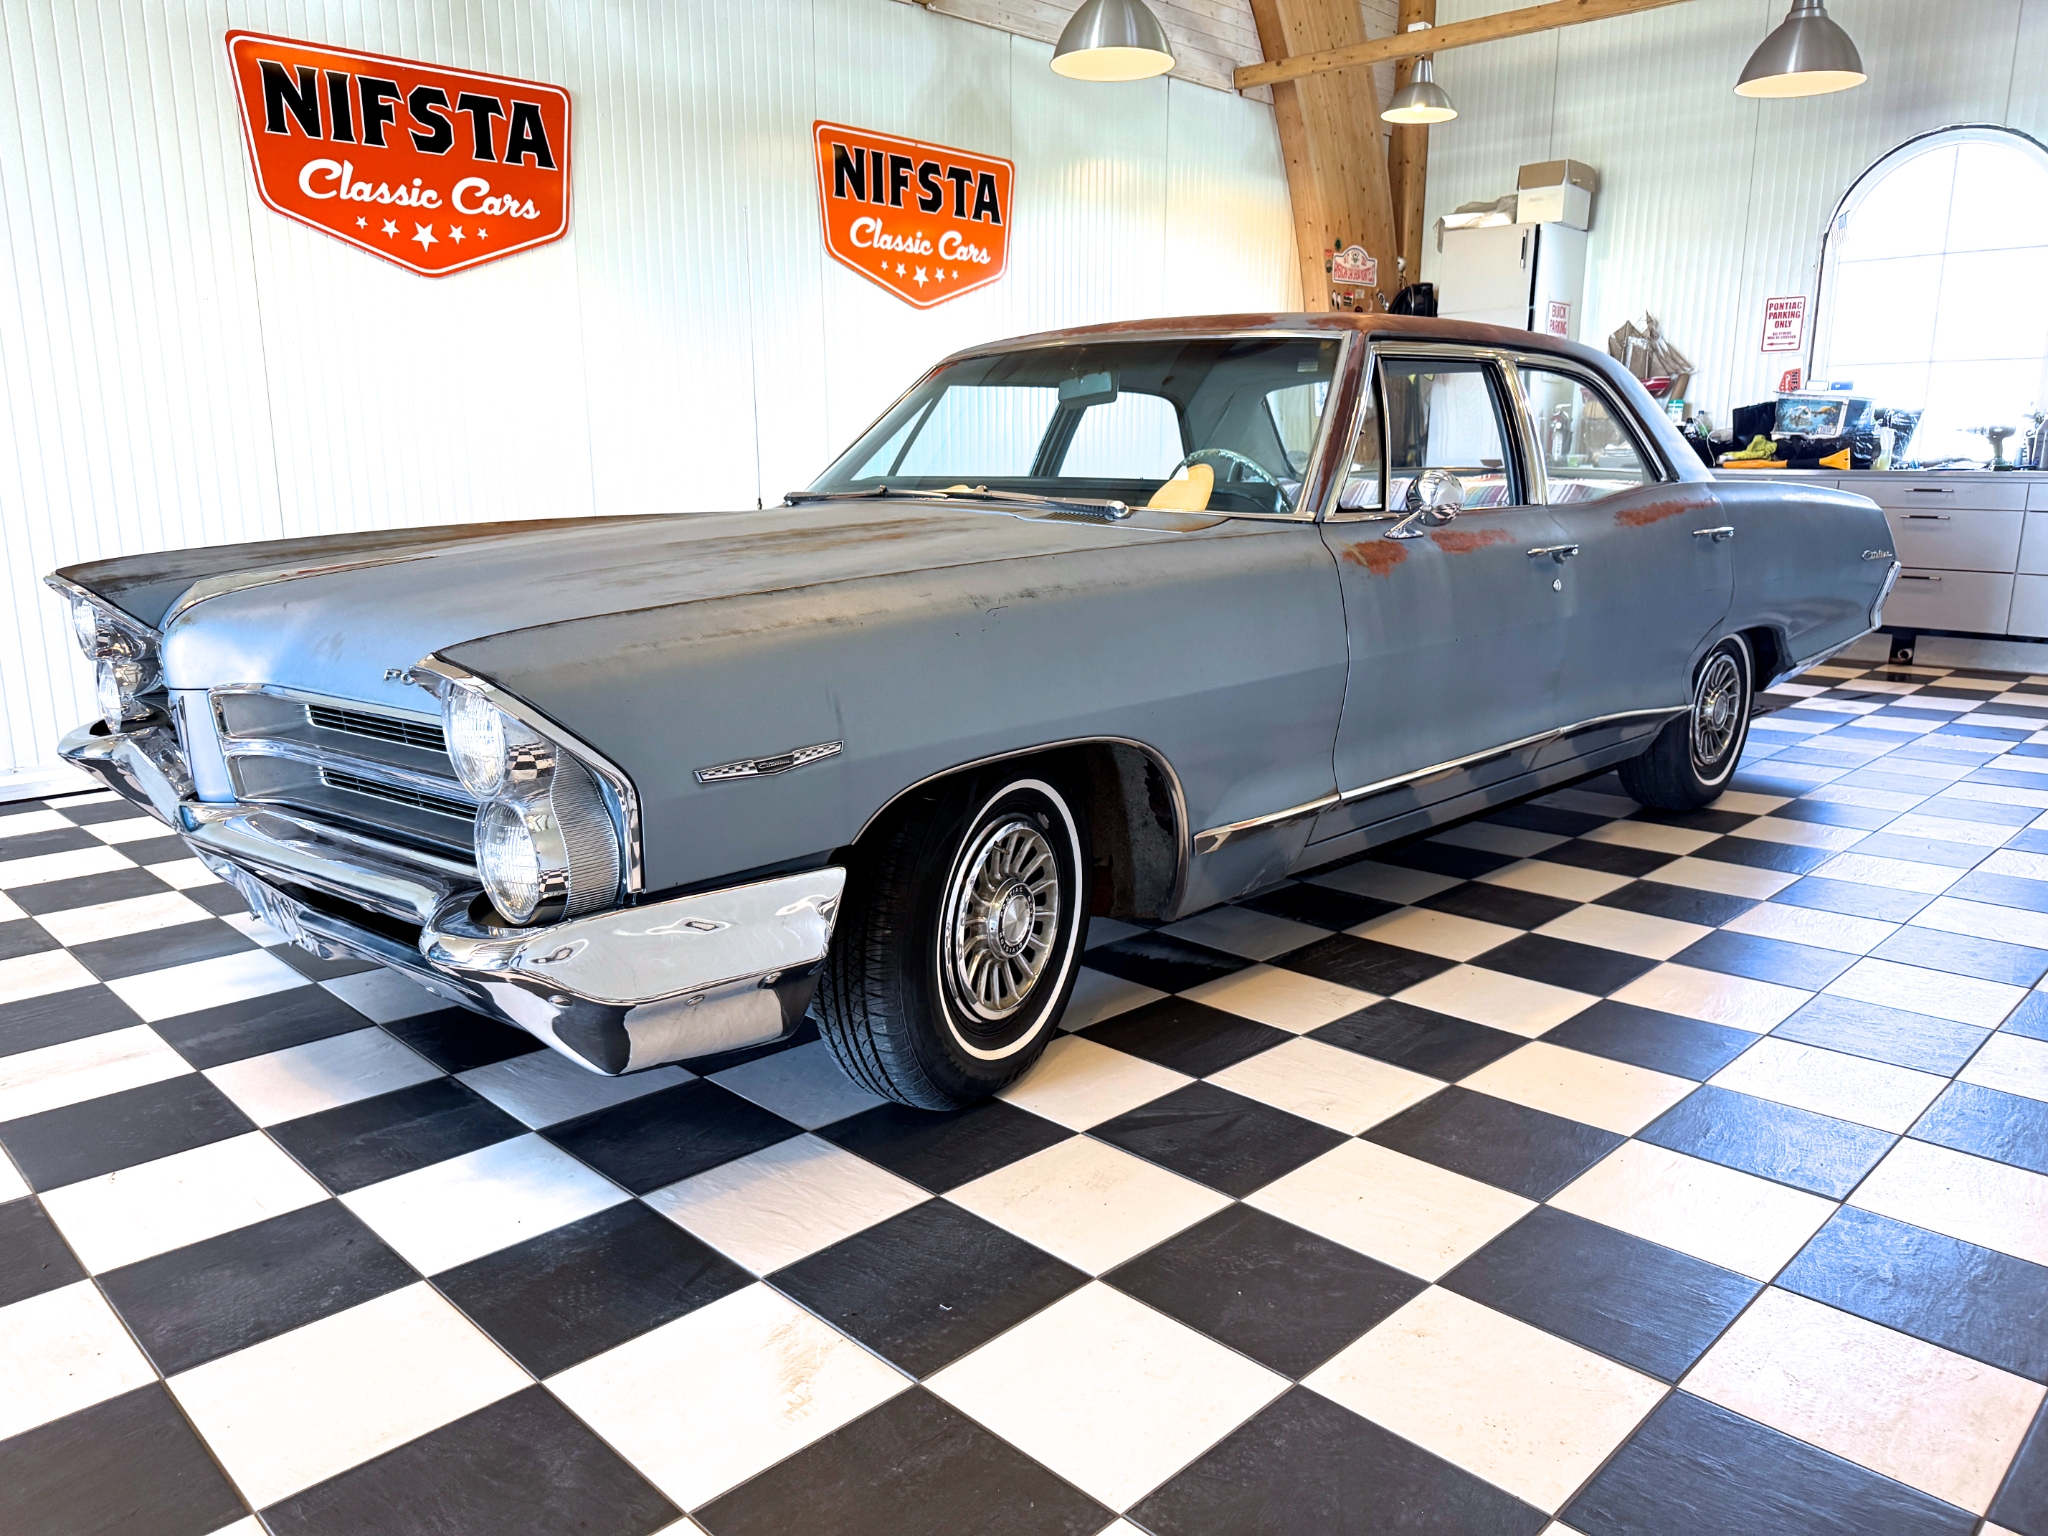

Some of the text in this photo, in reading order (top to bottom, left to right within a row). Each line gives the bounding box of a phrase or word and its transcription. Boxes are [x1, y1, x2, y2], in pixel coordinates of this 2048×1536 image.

[257, 58, 558, 170] NIFSTA
[298, 159, 540, 220] Classic Cars
[831, 141, 1003, 226] NIFSTA
[849, 216, 991, 264] Classic Cars
[1552, 304, 1566, 319] BUICK
[1768, 311, 1801, 320] PARKING
[1769, 302, 1802, 311] PONTIAC
[1774, 320, 1793, 329] ONLY
